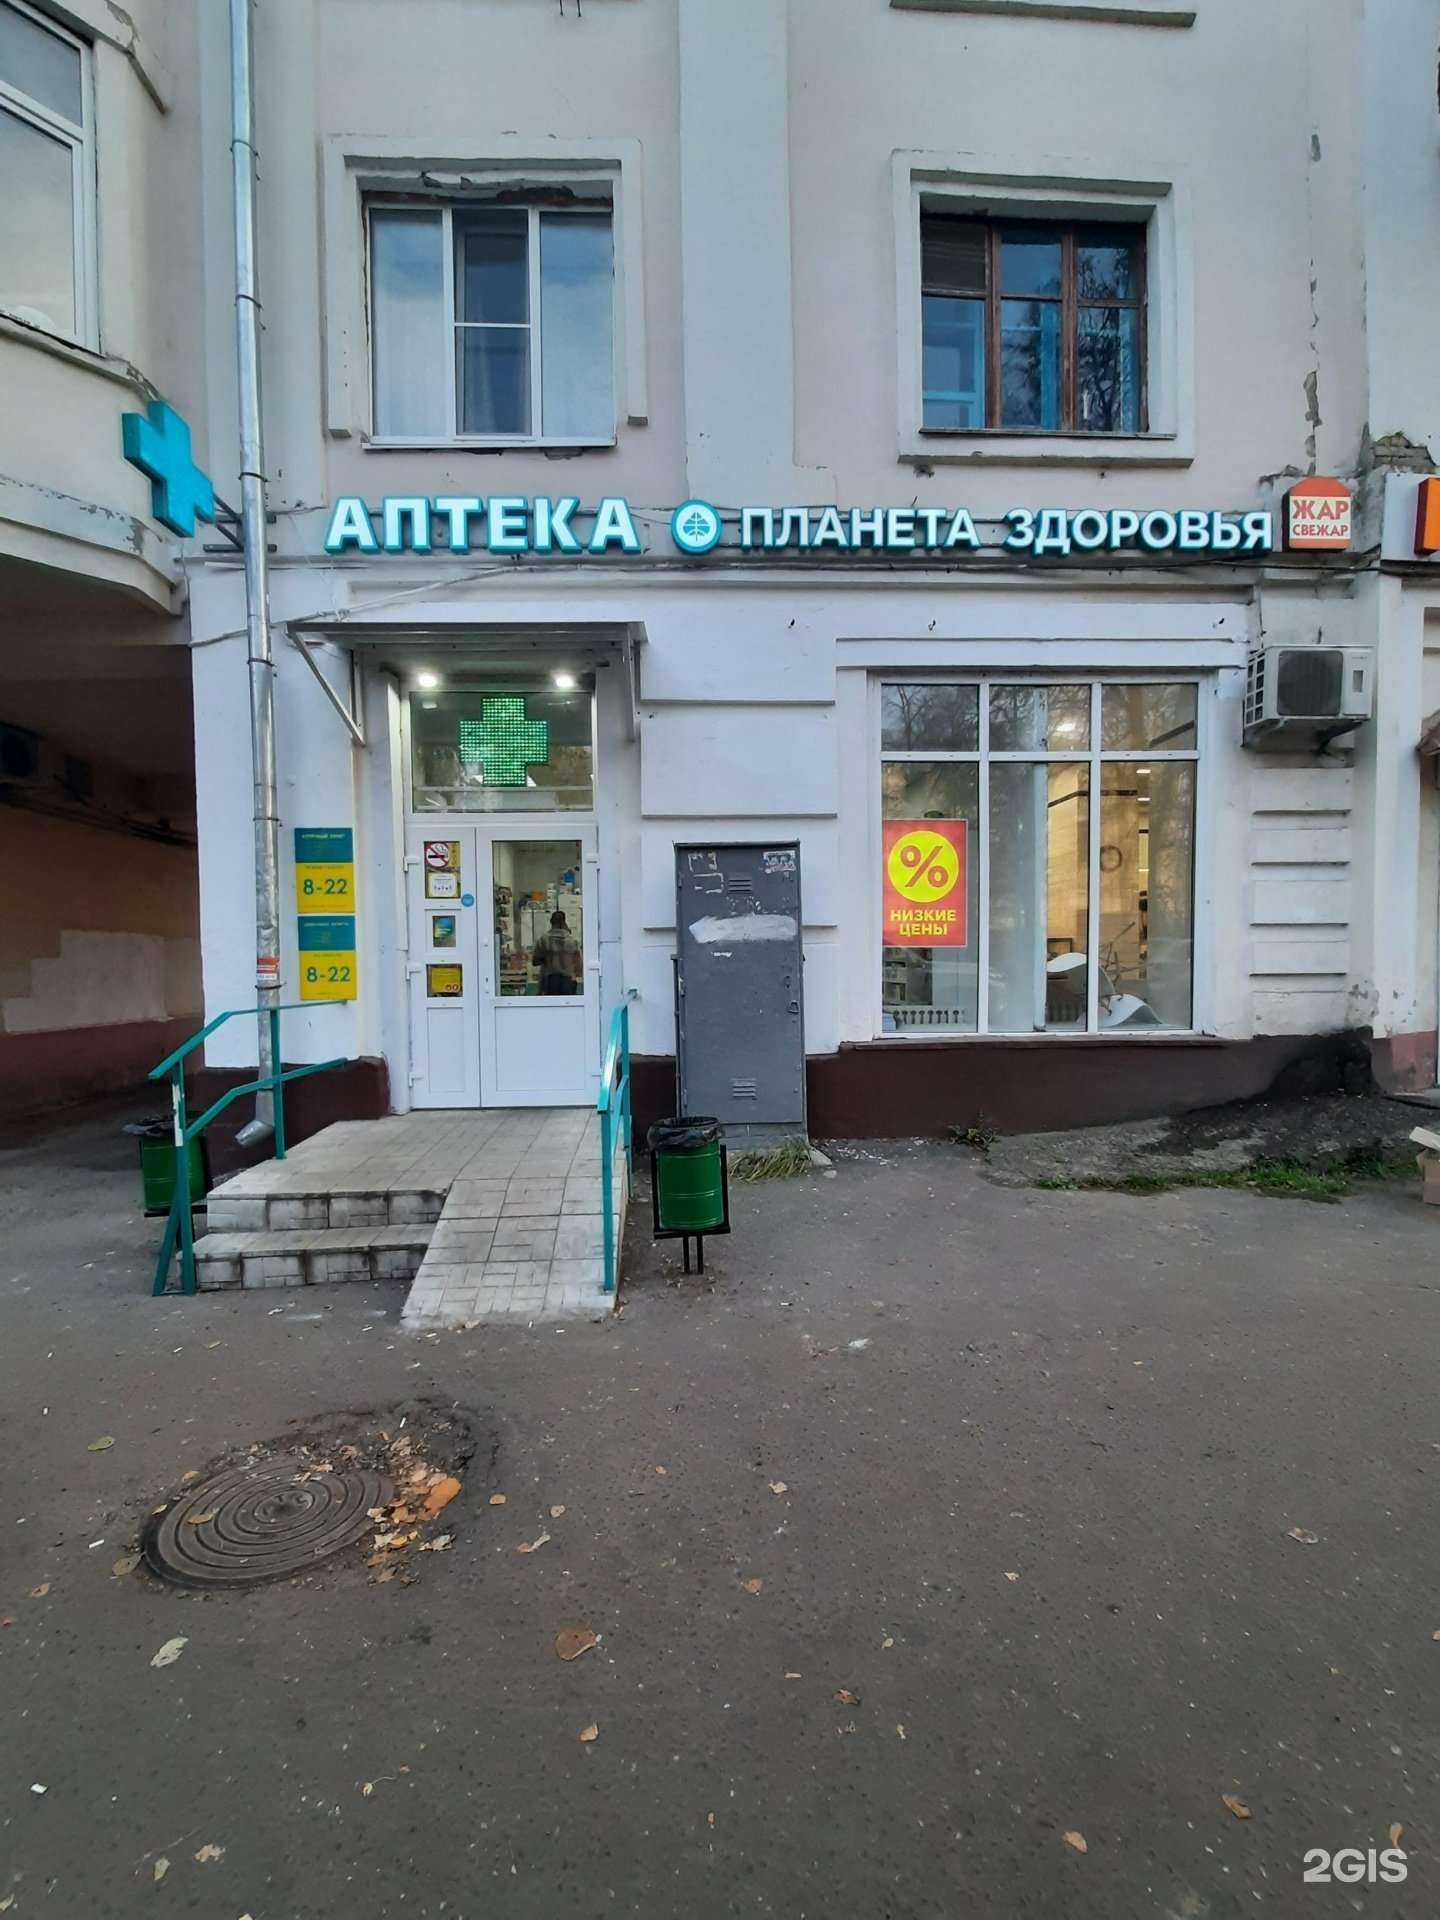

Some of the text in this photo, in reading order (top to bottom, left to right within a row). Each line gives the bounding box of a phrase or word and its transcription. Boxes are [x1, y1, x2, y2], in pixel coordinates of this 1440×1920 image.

[1292, 499, 1350, 520] ЖАР
[325, 496, 641, 554] АПТЕКА
[740, 506, 1274, 555] ПЛАНЕТА ЗДОРОВЬЯ
[1292, 524, 1349, 537] СВЕЖАР
[303, 878, 347, 895] 8-22
[890, 909, 956, 922] НИЗКИЕ
[900, 923, 947, 936] ЦЕНЫ
[306, 966, 350, 982] 8-22
